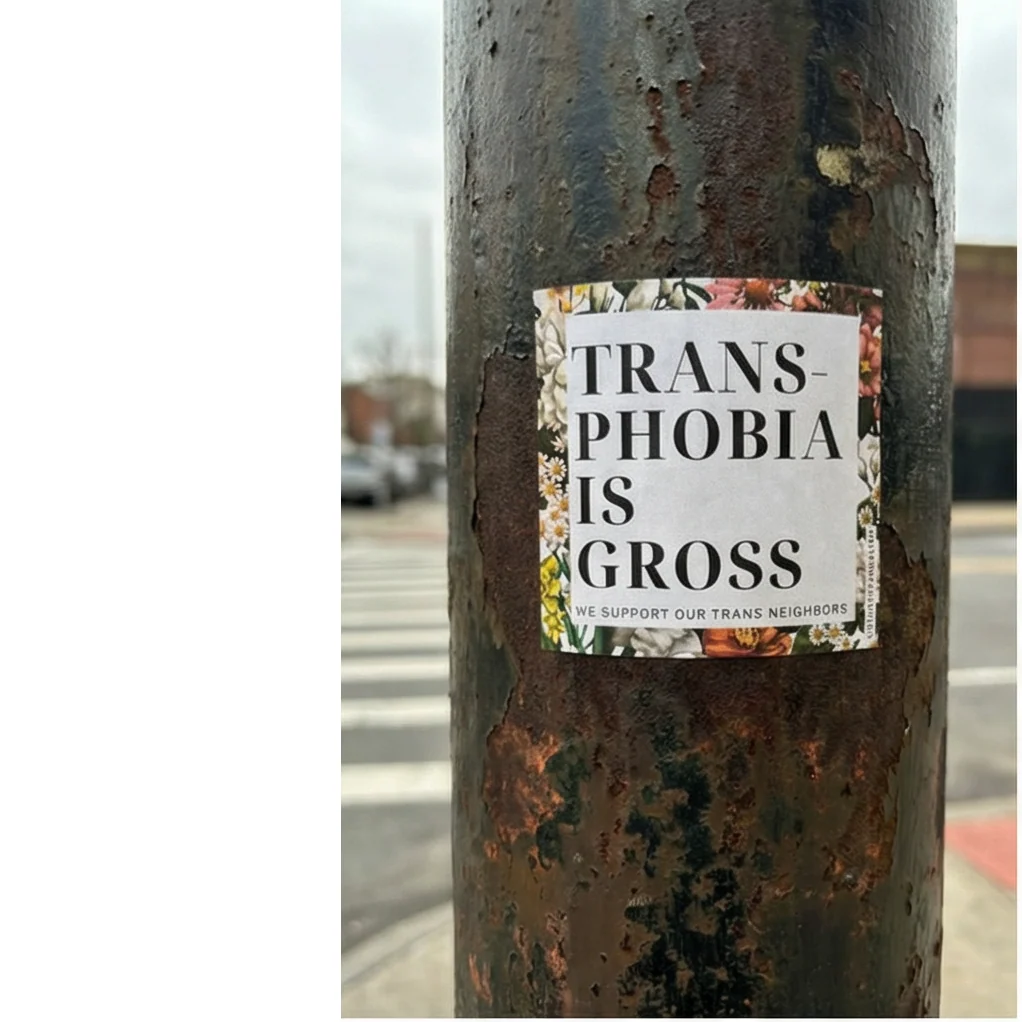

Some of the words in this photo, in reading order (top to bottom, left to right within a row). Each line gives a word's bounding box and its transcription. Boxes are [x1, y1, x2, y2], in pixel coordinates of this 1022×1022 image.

[571, 341, 828, 396] TRANS-
[575, 408, 843, 462] PHOBIA
[576, 476, 635, 526] IS
[578, 540, 802, 590] GROSS
[576, 606, 596, 618] WE
[601, 607, 668, 620] SUPPORT
[674, 609, 706, 620] OUR
[712, 608, 762, 620] TRANS
[768, 604, 848, 618] NEIGHBORS
